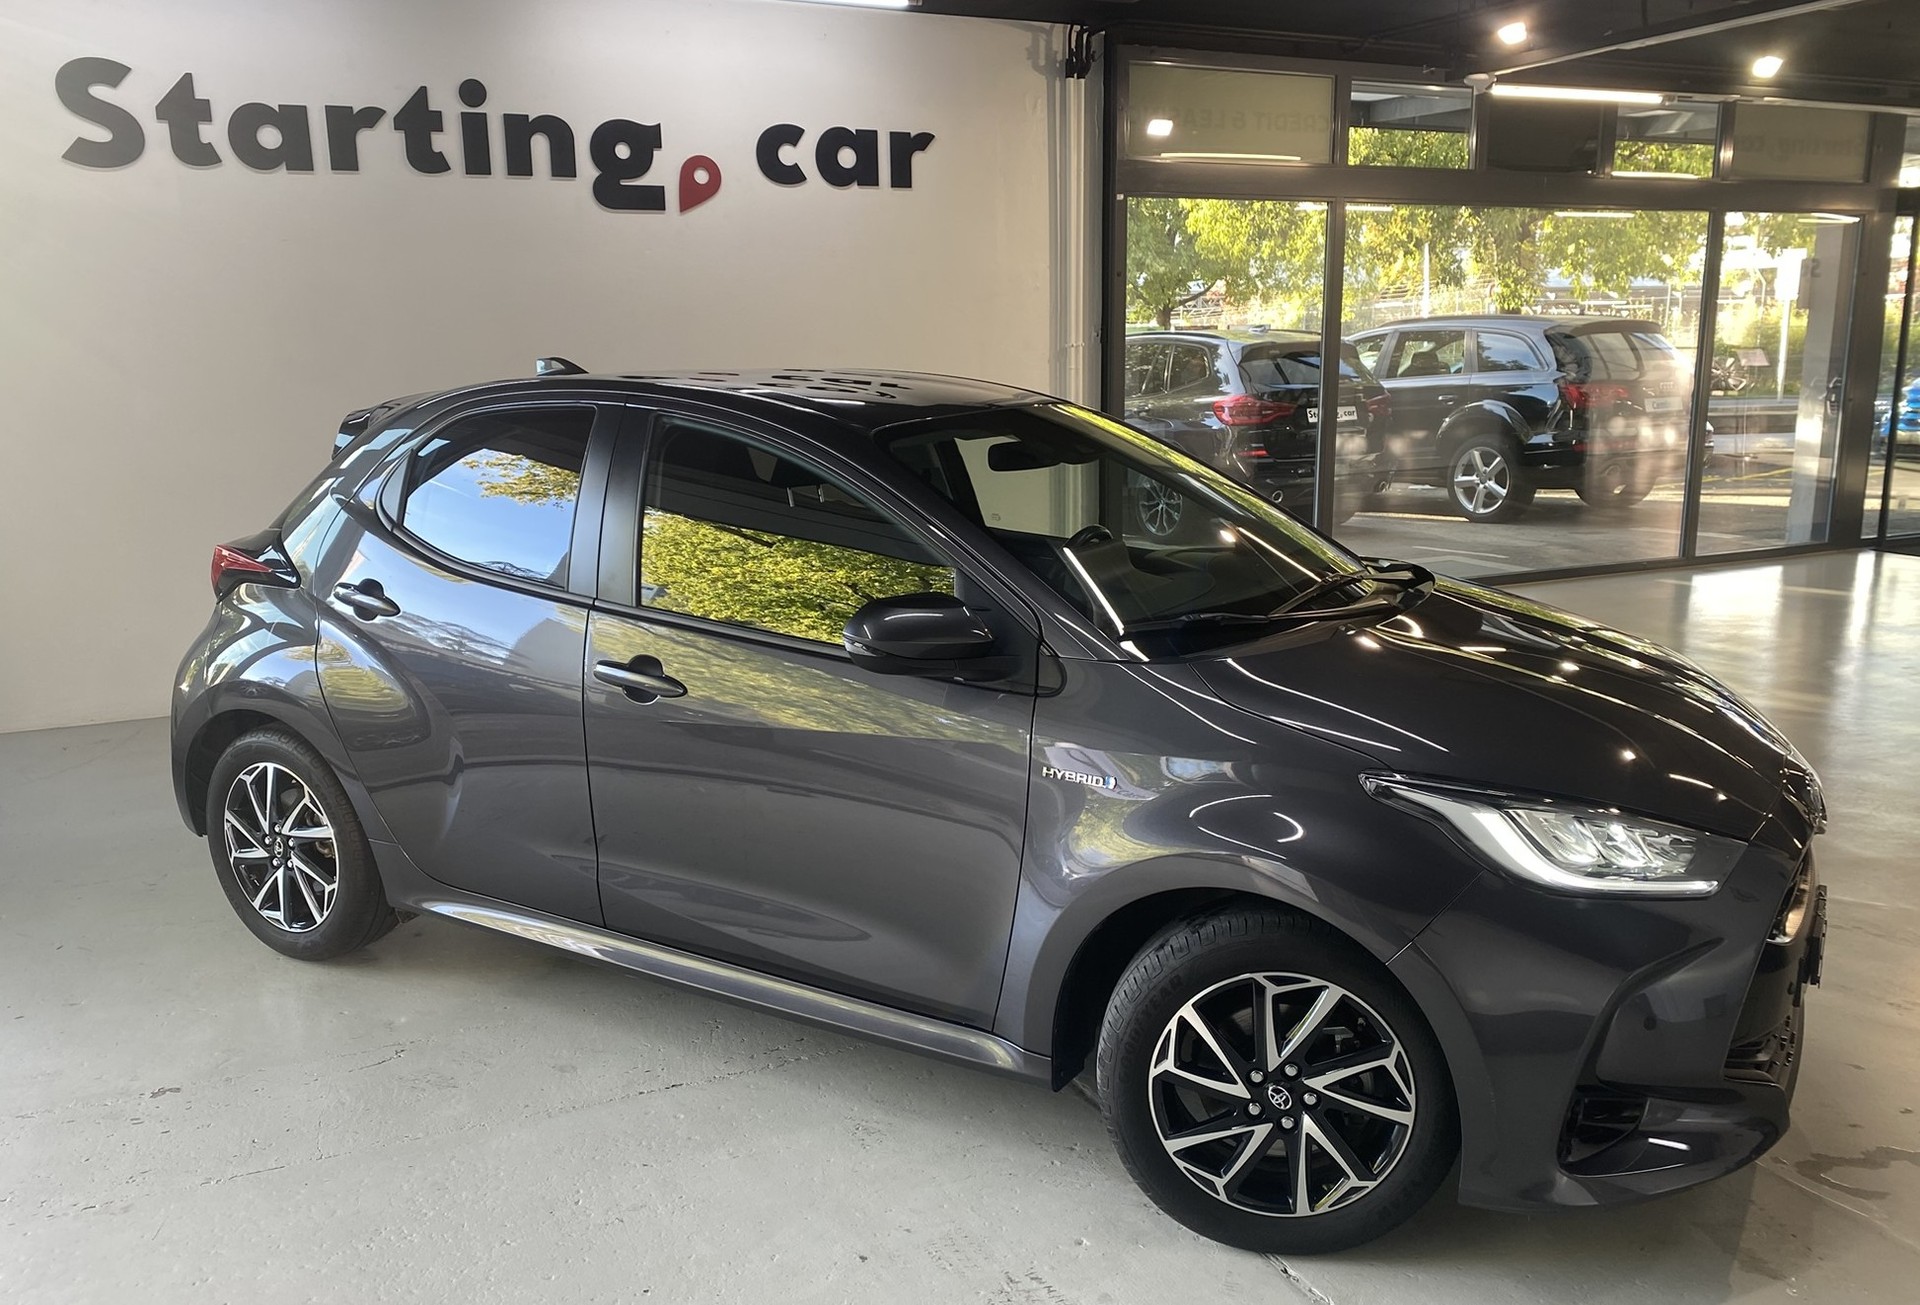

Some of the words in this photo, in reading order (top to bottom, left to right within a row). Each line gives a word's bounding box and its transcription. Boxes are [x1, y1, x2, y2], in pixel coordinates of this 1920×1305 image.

[55, 56, 666, 211] Starting
[756, 123, 935, 190] car
[1042, 766, 1106, 788] HYBRID
